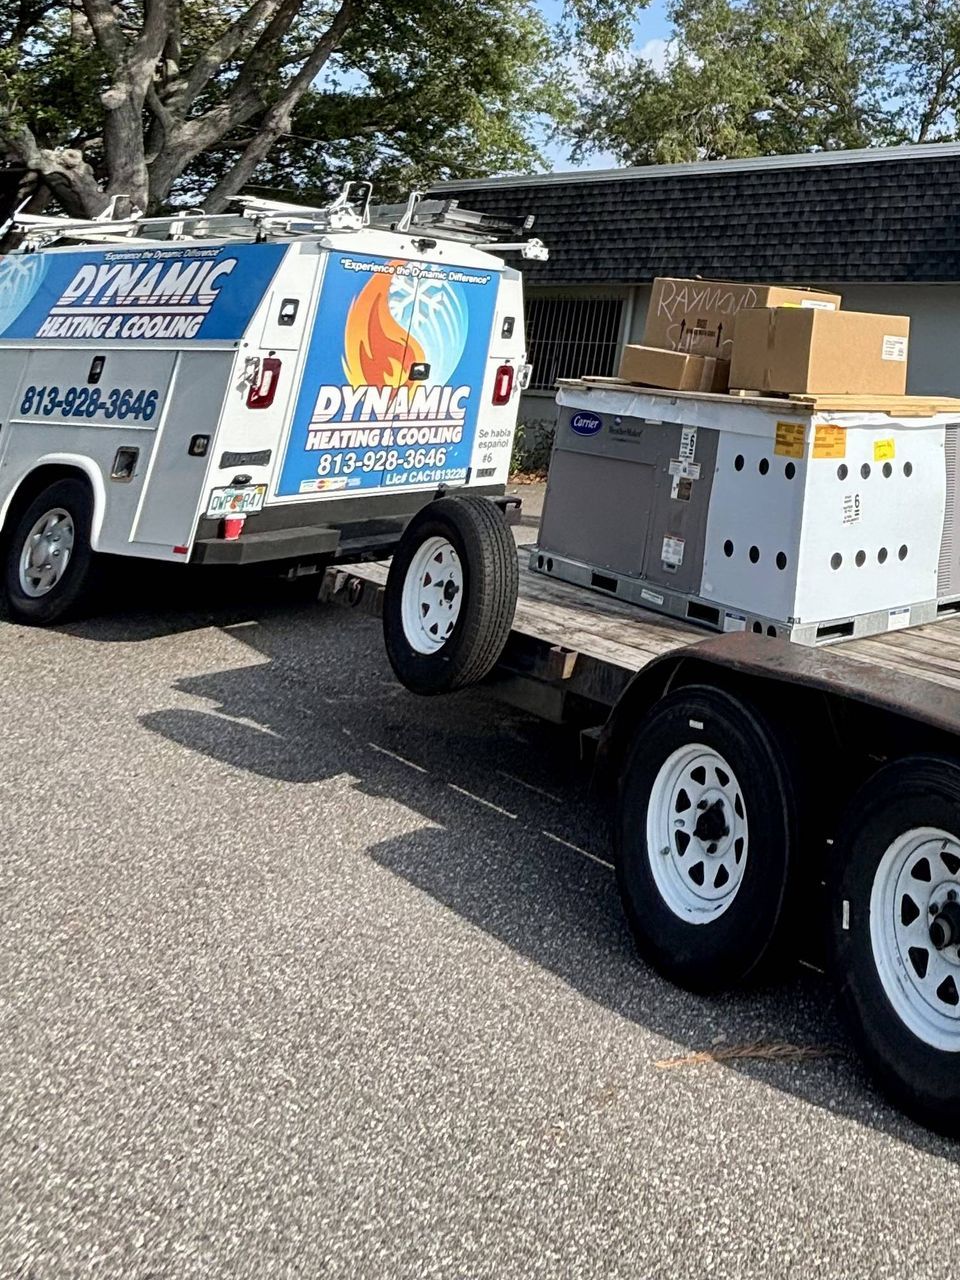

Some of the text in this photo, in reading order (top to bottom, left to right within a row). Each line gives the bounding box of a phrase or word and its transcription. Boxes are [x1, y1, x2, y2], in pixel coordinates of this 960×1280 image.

[56, 258, 237, 306] DYNAMIC
[340, 258, 491, 285] "Experience the Dynamic Difference"
[34, 315, 205, 339] HEATING & COOLING
[20, 385, 159, 421] 813-928-3646
[311, 384, 472, 423] DYNAMIC
[478, 428, 512, 439] Se habla
[573, 416, 599, 429] Carrier
[305, 425, 463, 451] HEATING & COOLING
[478, 439, 509, 450] español
[317, 447, 447, 476] 813-928-3646
